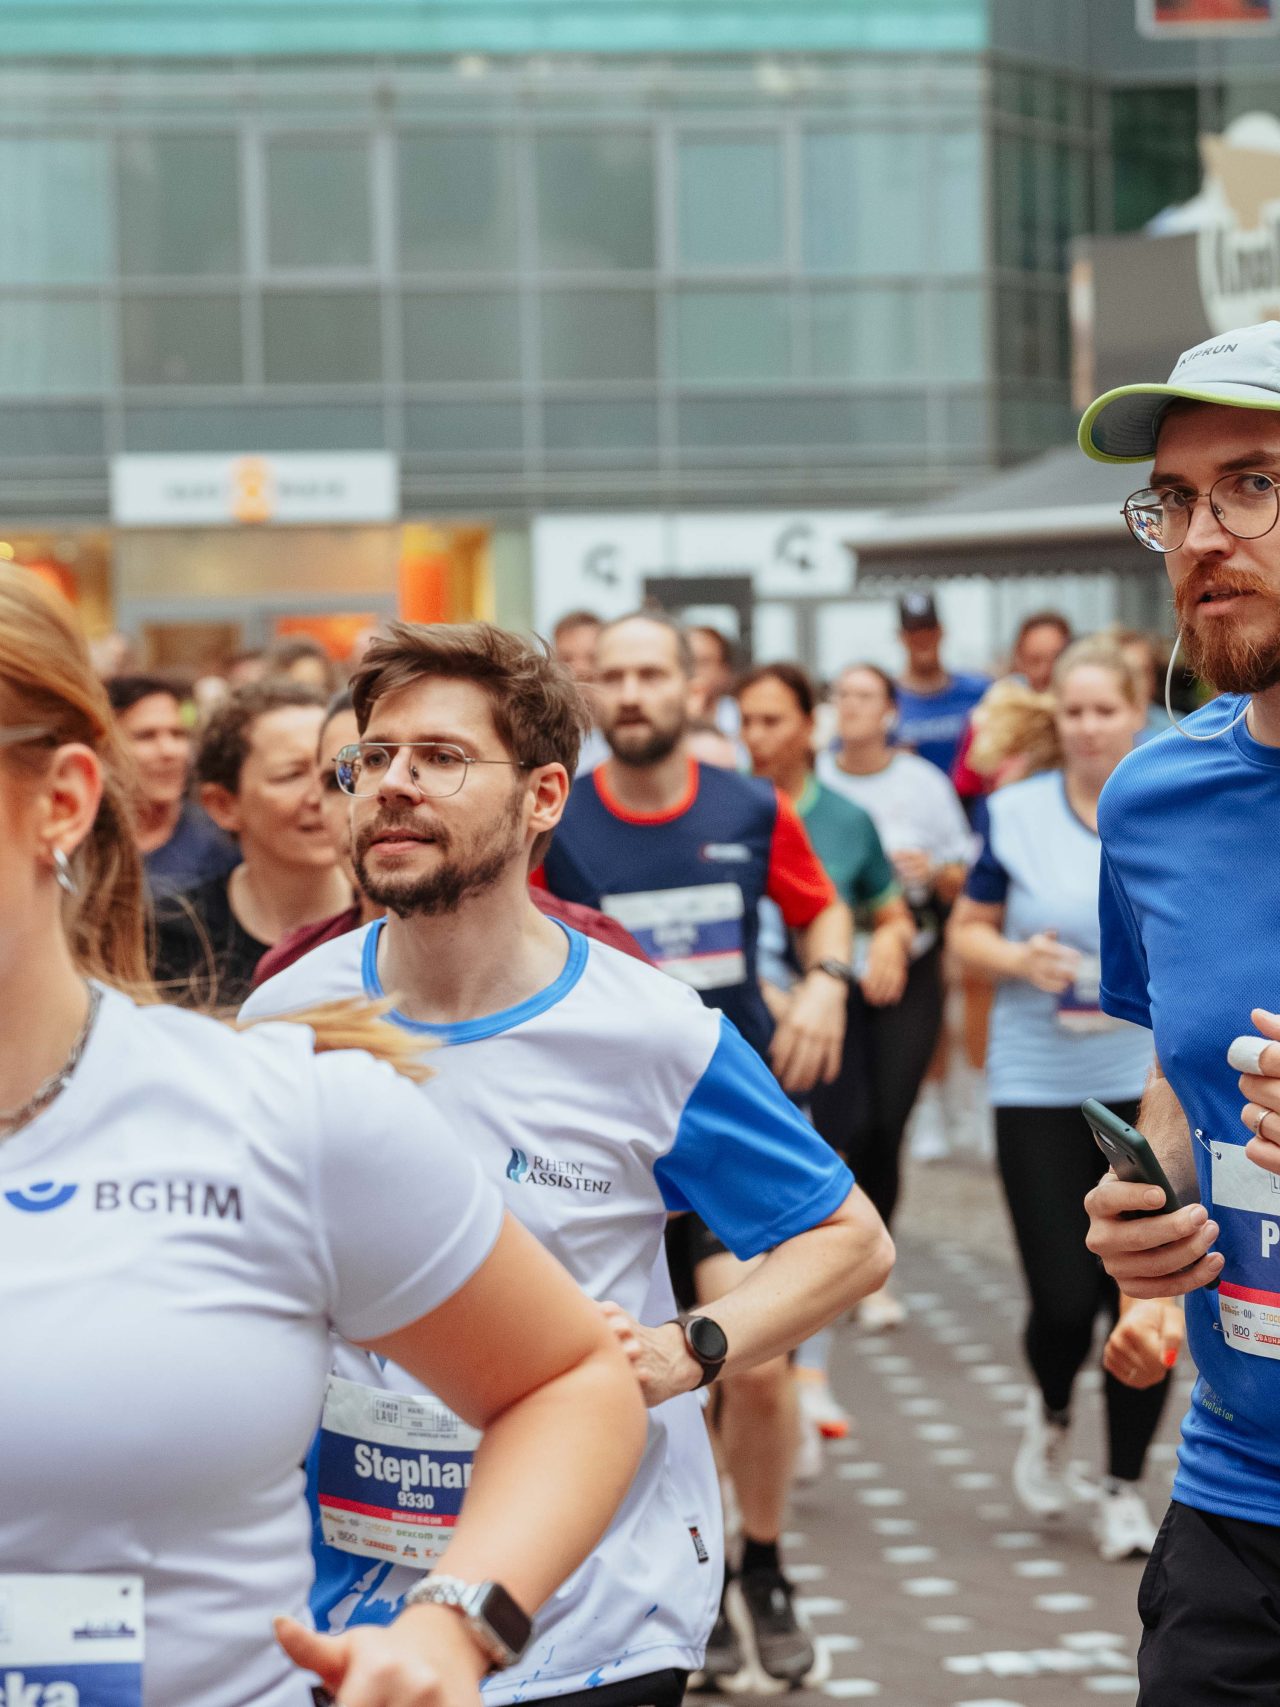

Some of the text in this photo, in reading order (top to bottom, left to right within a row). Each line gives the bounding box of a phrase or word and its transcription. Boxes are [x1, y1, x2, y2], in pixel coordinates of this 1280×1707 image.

[533, 1155, 584, 1175] RHEIN
[525, 1171, 612, 1195] ASSISTENZ
[95, 1180, 242, 1222] BGHM
[1234, 1324, 1250, 1337] BDO
[1202, 1398, 1234, 1422] evolution
[397, 1491, 434, 1510] 9330
